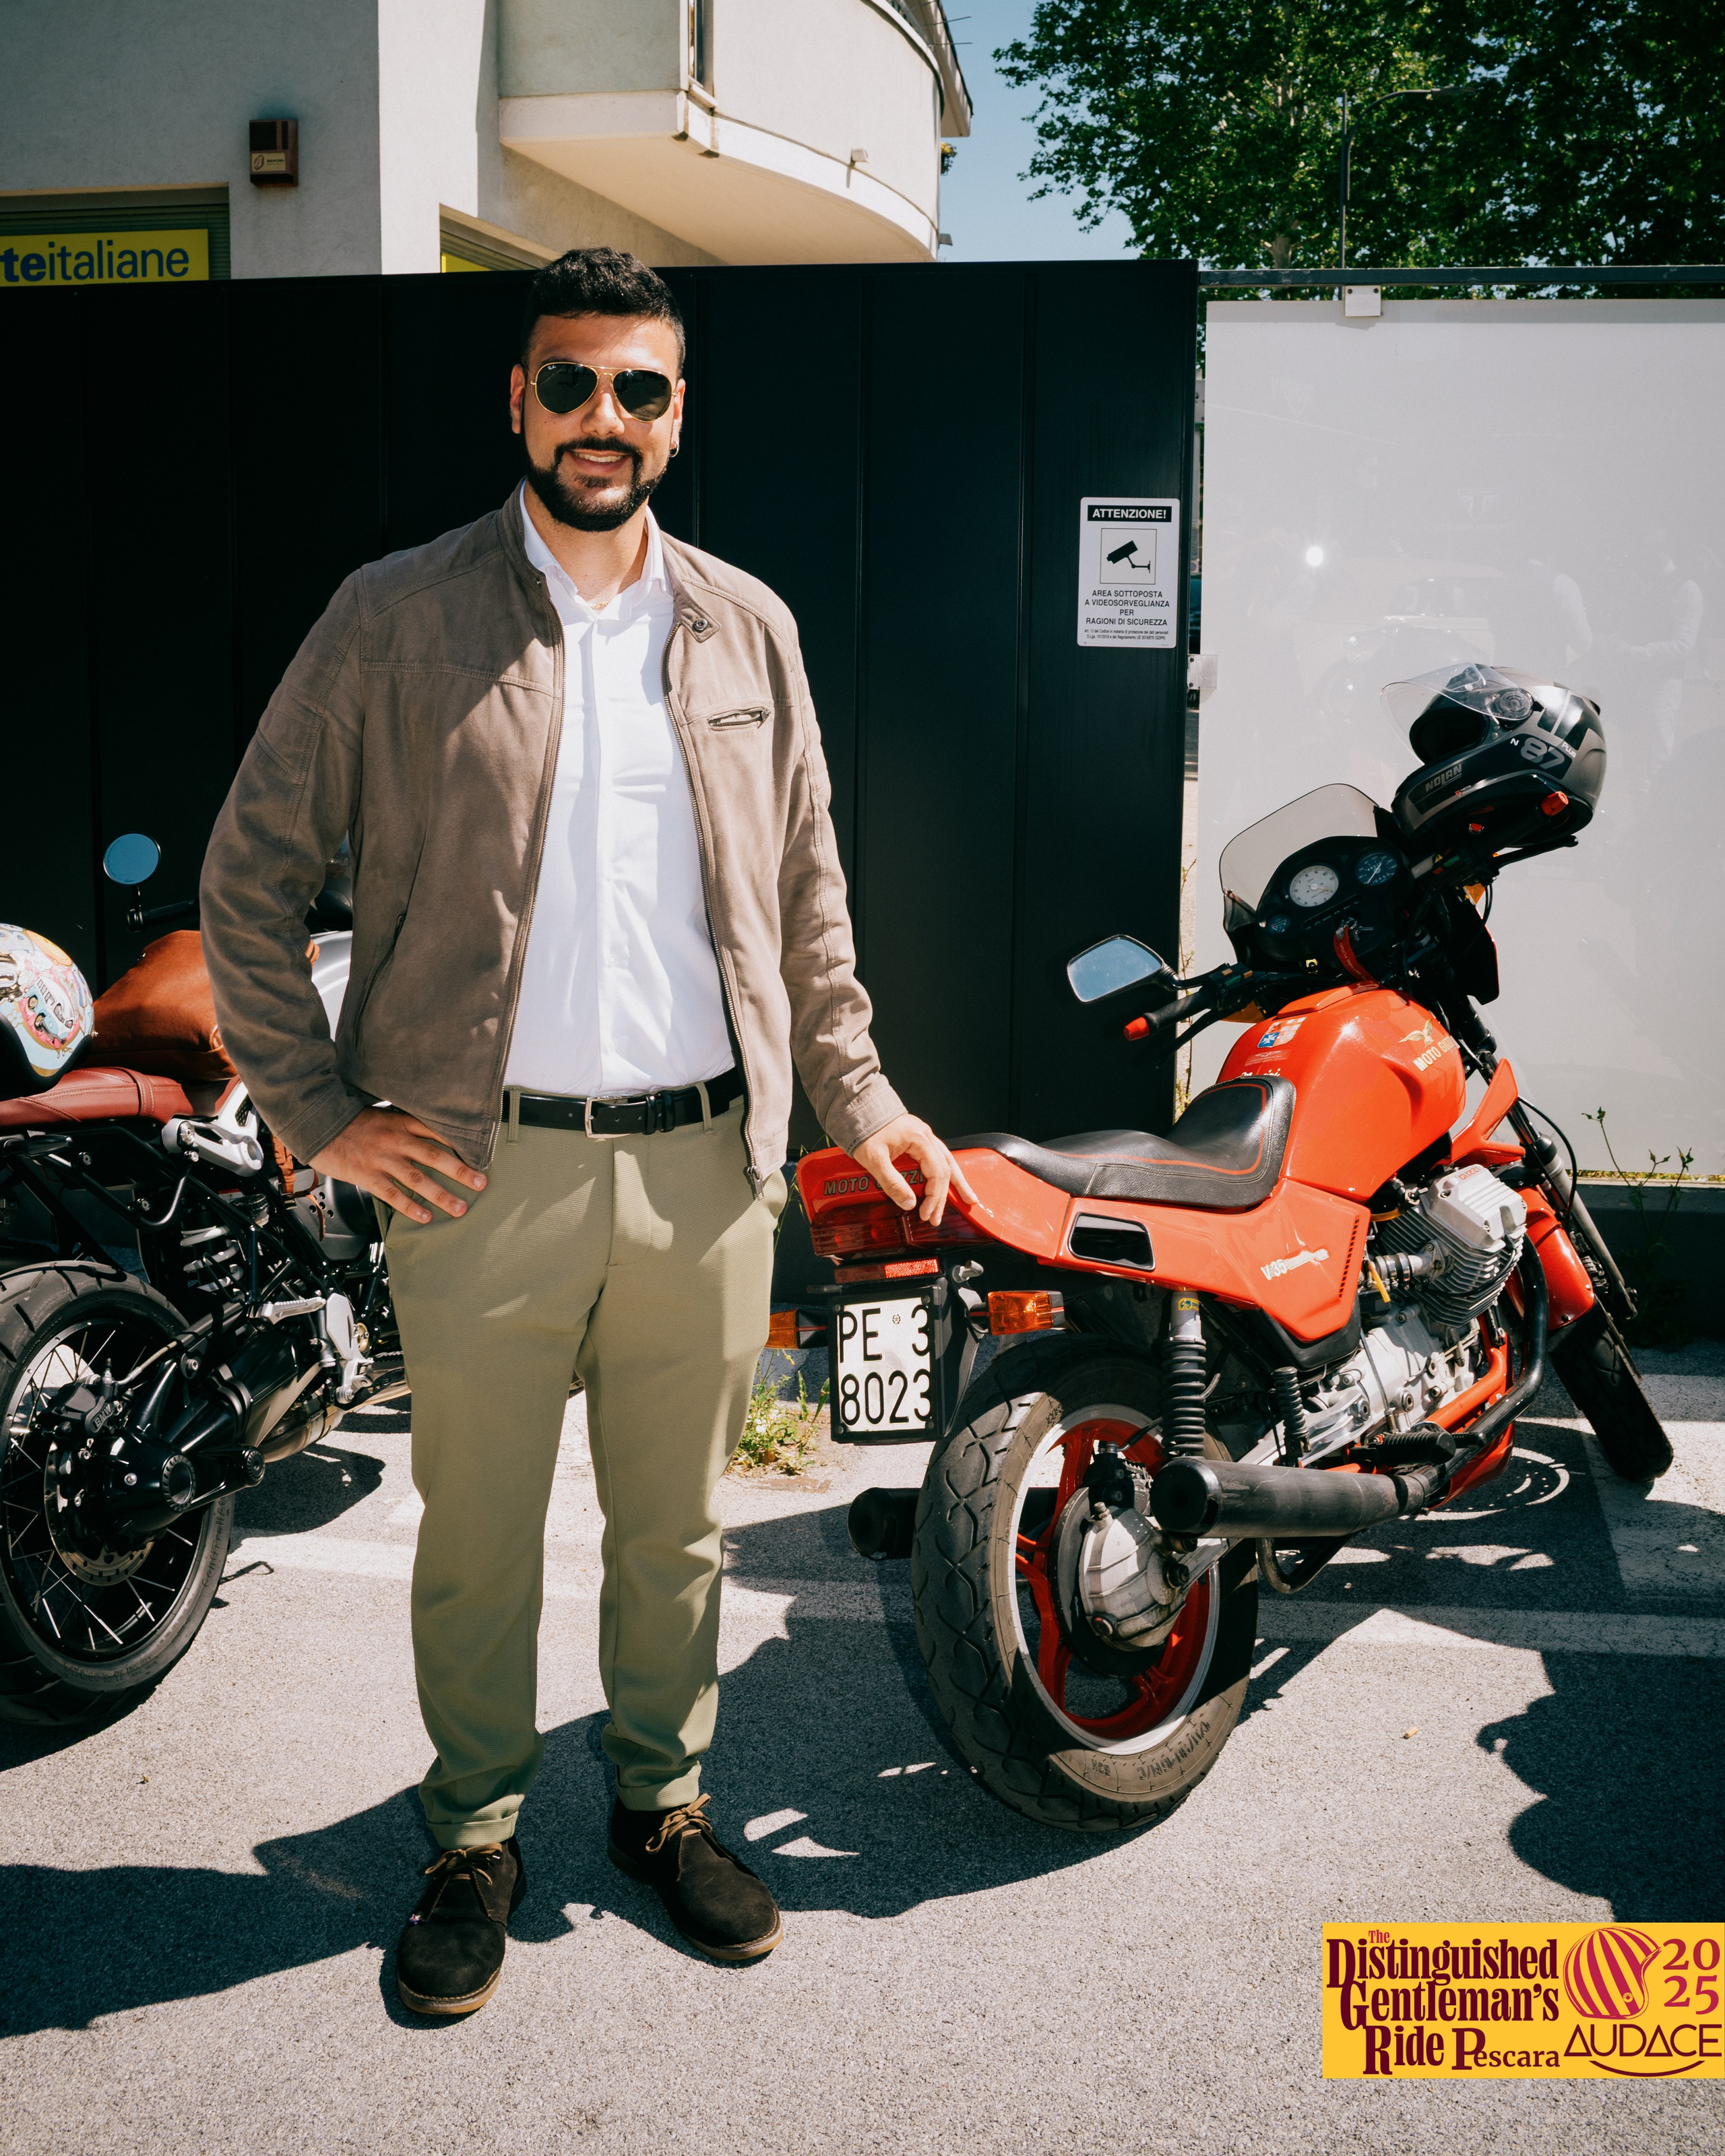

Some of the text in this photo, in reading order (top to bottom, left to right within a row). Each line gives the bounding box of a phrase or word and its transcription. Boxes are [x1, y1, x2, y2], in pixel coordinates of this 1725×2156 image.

[1092, 508, 1166, 519] ATTENZIONE!
[1092, 599, 1170, 608] VIDEOSORVEGLIANZA
[1114, 590, 1163, 598] SOTTOPOSTA
[1520, 737, 1565, 769] 87
[1425, 763, 1462, 792] NOLAN
[1412, 1046, 1442, 1072] MOTO
[1458, 1166, 1481, 1180] GUZZI
[823, 1176, 869, 1196] MOTO
[840, 1304, 931, 1364] PE 3
[840, 1368, 931, 1426] 8023
[94, 1403, 111, 1428] BMW
